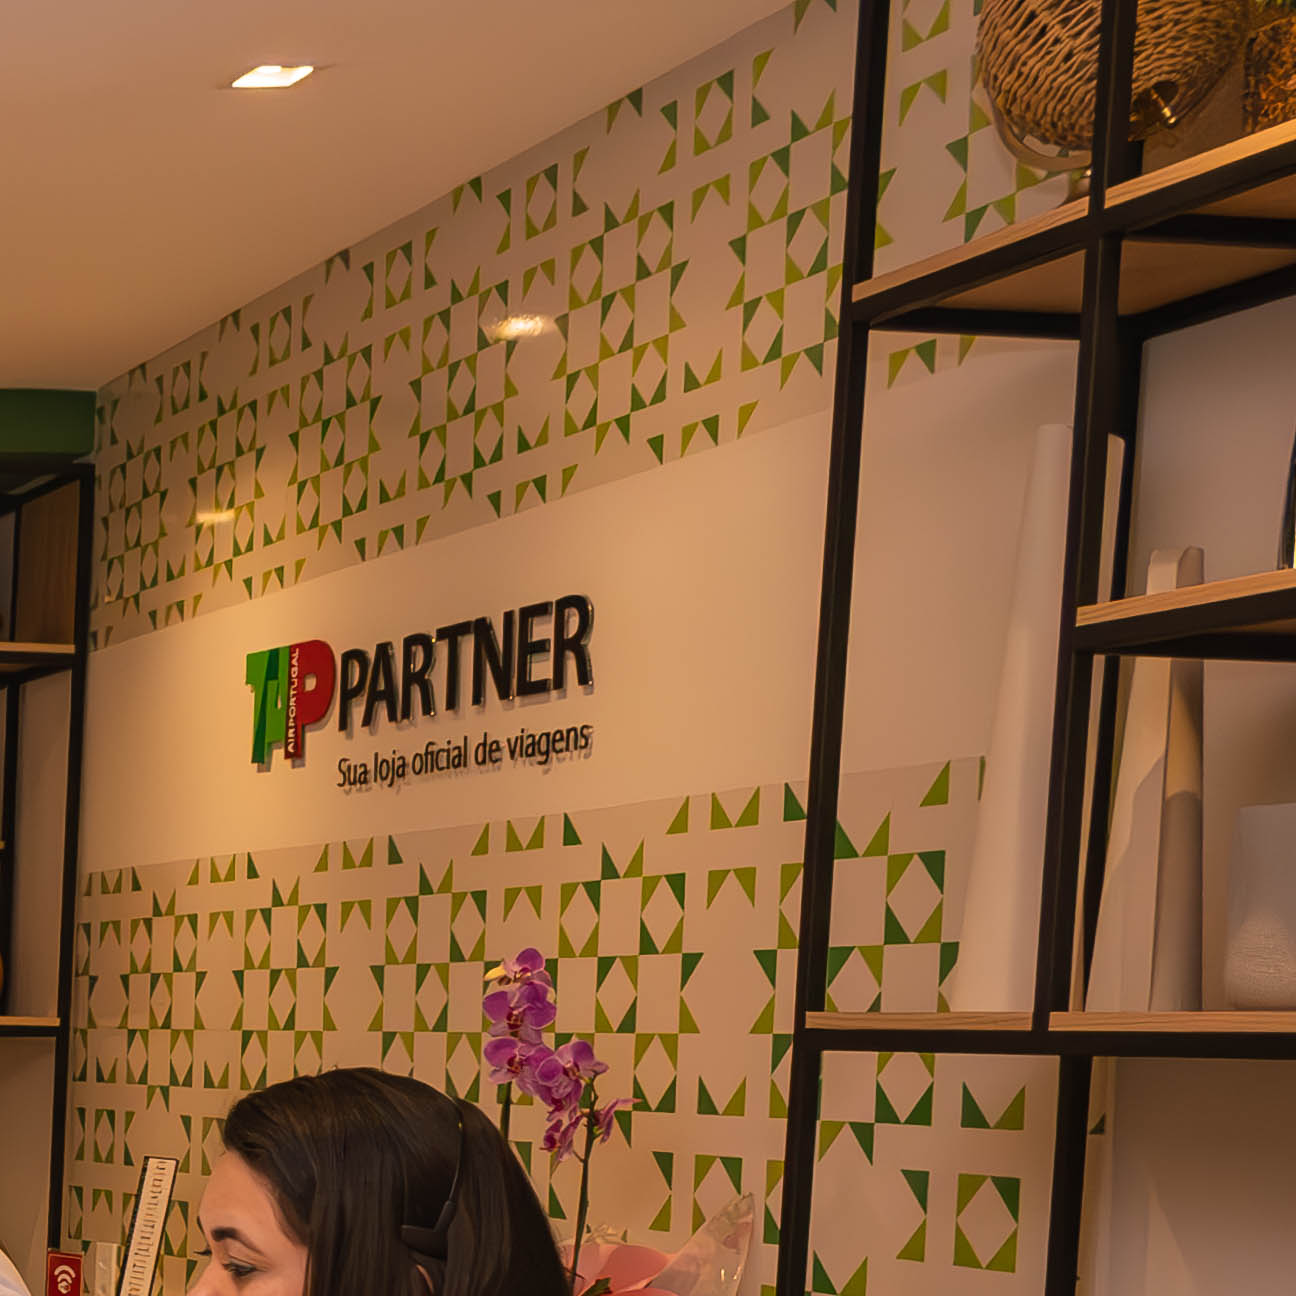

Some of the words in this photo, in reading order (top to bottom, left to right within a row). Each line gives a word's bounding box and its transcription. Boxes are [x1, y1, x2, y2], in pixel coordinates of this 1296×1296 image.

[246, 639, 336, 764] TAP
[338, 594, 595, 732] PARTNER
[336, 757, 368, 788] Sua
[373, 749, 406, 788] loja
[411, 735, 468, 776] oficial
[474, 731, 503, 766] de
[506, 724, 594, 766] viagens
